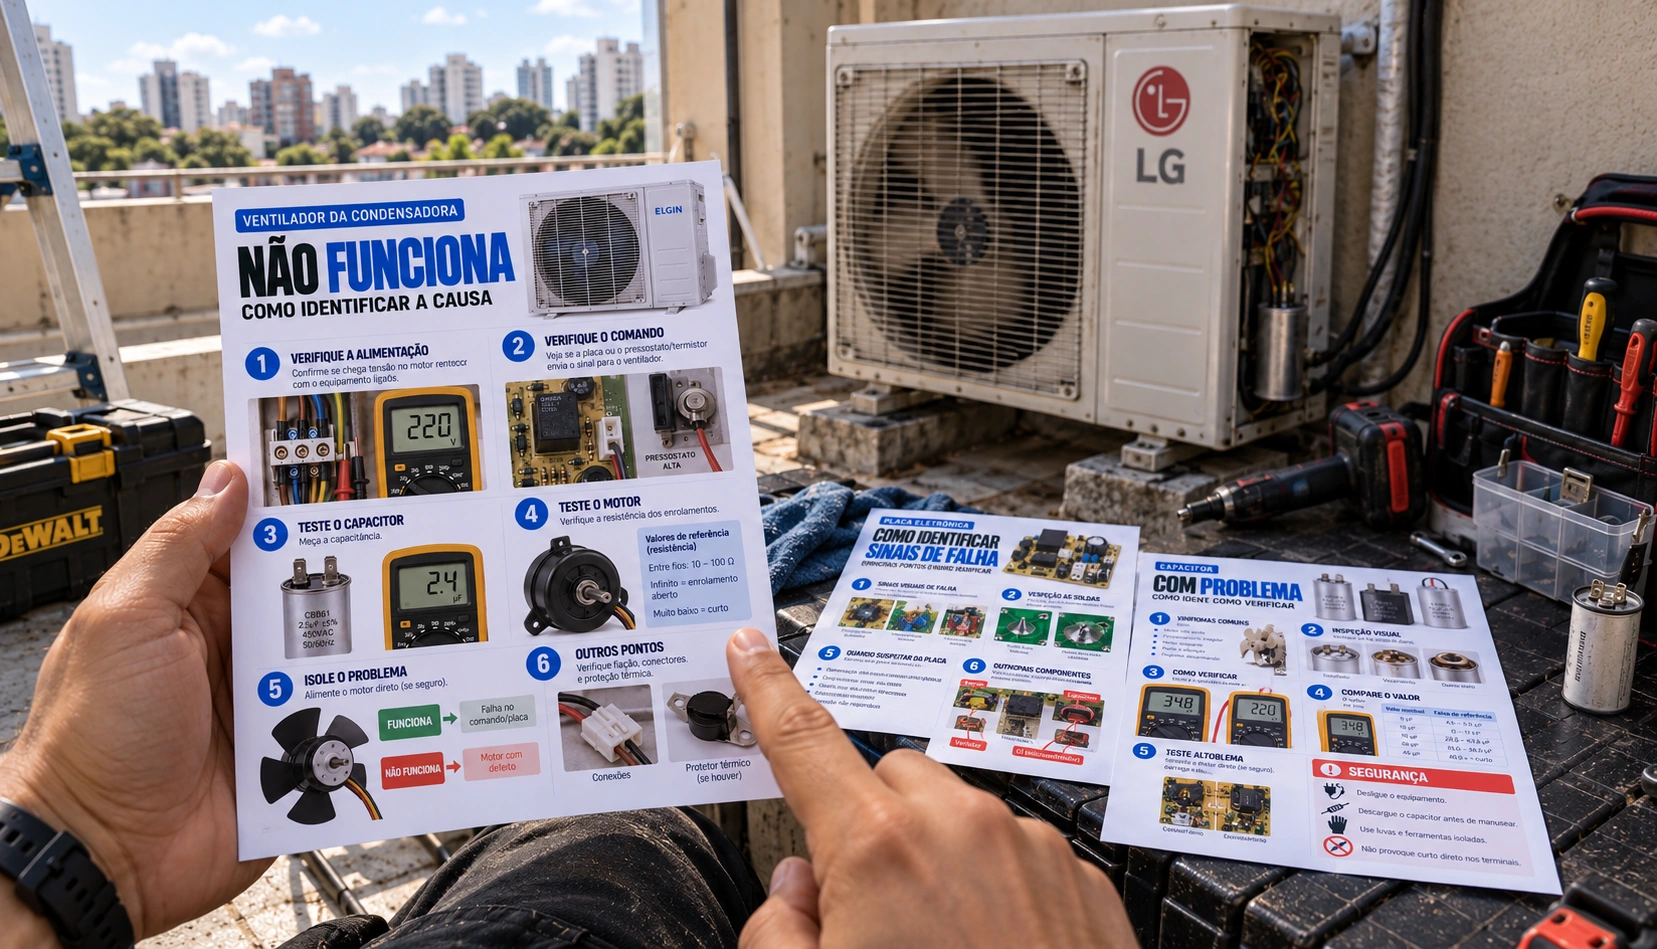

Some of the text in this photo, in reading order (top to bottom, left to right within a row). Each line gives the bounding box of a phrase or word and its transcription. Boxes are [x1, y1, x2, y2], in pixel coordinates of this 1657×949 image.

[1136, 147, 1185, 185] LG
[243, 204, 458, 227] VENTILADOR DA CONDENSADORA
[654, 205, 683, 215] ELGIN
[237, 231, 516, 298] NÃO FUNCIONA
[241, 290, 493, 320] COMO IDENTIFICAR A CAUSA
[544, 327, 665, 347] VERIFIQUE O COMANDO
[512, 336, 525, 355] 2
[564, 350, 574, 359] se
[575, 350, 581, 358] a
[583, 348, 603, 359] placa
[604, 347, 615, 355] ou
[624, 340, 708, 357] pressostato/termistor
[290, 343, 429, 365] VERIFIQUE A ALIMENTAÇÃO
[576, 357, 595, 369] sinal
[597, 357, 614, 368] para
[623, 353, 664, 365] ventilador.
[256, 354, 266, 373] 1
[292, 360, 434, 378] Confirme se chega no motor
[293, 380, 310, 389] com
[319, 375, 371, 388] equipamento
[407, 412, 451, 439] 220
[645, 451, 696, 462] PRESSOSTATO
[662, 462, 681, 470] ALTA
[558, 495, 641, 513] TESTE O MOTOR
[524, 504, 538, 523] 4
[560, 505, 720, 526] Verifique a resistência dos enrolamentos.
[298, 514, 404, 533] TESTE O CAPACITOR
[264, 525, 278, 544] 3
[299, 535, 329, 547] Meça a
[645, 529, 729, 543] Valores de referência
[872, 528, 1000, 549] COMO IDENTIFICAR
[646, 542, 697, 555] (resistência)
[865, 543, 921, 561] SINAIS
[921, 546, 945, 562] DE
[945, 547, 998, 567] FALHA
[648, 557, 735, 573] Entre fios: 10 100 Ω
[427, 570, 457, 595] 2.4
[650, 574, 738, 589] Infinito enrolamento
[1153, 574, 1304, 601] COM PROBLEMA
[651, 590, 678, 600] aberto
[1008, 591, 1016, 599] 2
[1152, 594, 1295, 609] COMO COMO VERIFICAR
[653, 604, 729, 618] Muito baixo curto
[1308, 626, 1317, 634] 2
[1373, 630, 1401, 638] VISUAL
[575, 641, 664, 660] OUTROS PONTOS
[826, 649, 834, 657] 5
[537, 653, 550, 673] 6
[576, 654, 688, 674] Verifique fiação, conectores.
[969, 662, 979, 670] 6
[304, 666, 407, 686] ISOLE O PROBLEMA
[577, 669, 654, 684] e proteção térmica.
[1149, 668, 1158, 676] 3
[1172, 669, 1196, 677] COMO
[269, 678, 282, 699] 5
[304, 677, 448, 699] Alimente o motor direto (se seguro).
[1314, 688, 1325, 697] 4
[1341, 689, 1420, 702] COMPARE VALOR
[481, 703, 502, 713] Falha
[1251, 702, 1276, 716] 220
[387, 716, 433, 730] FUNCIONA
[469, 713, 529, 727] comando/placa
[480, 751, 523, 762] Motor com
[1139, 746, 1149, 755] 5
[1166, 749, 1192, 758] TESTE
[385, 763, 441, 778] NÃO FUNCIONA
[685, 758, 751, 772] Protetor térmico
[592, 771, 631, 782] Conexões
[697, 771, 742, 784] (se houver)
[1349, 766, 1429, 784] SEGURANÇA
[1356, 789, 1389, 799] Desligue
[1358, 807, 1518, 828] Descargue capacitor antes de manusear.
[1376, 827, 1397, 836] luvas
[1404, 830, 1452, 841] ferramentas
[1453, 834, 1488, 844] isoladas.
[1361, 845, 1377, 854] Não
[1378, 848, 1416, 858] provoque
[1417, 851, 1438, 859] curto
[1440, 852, 1464, 861] direto
[1481, 856, 1522, 867] terminais.
